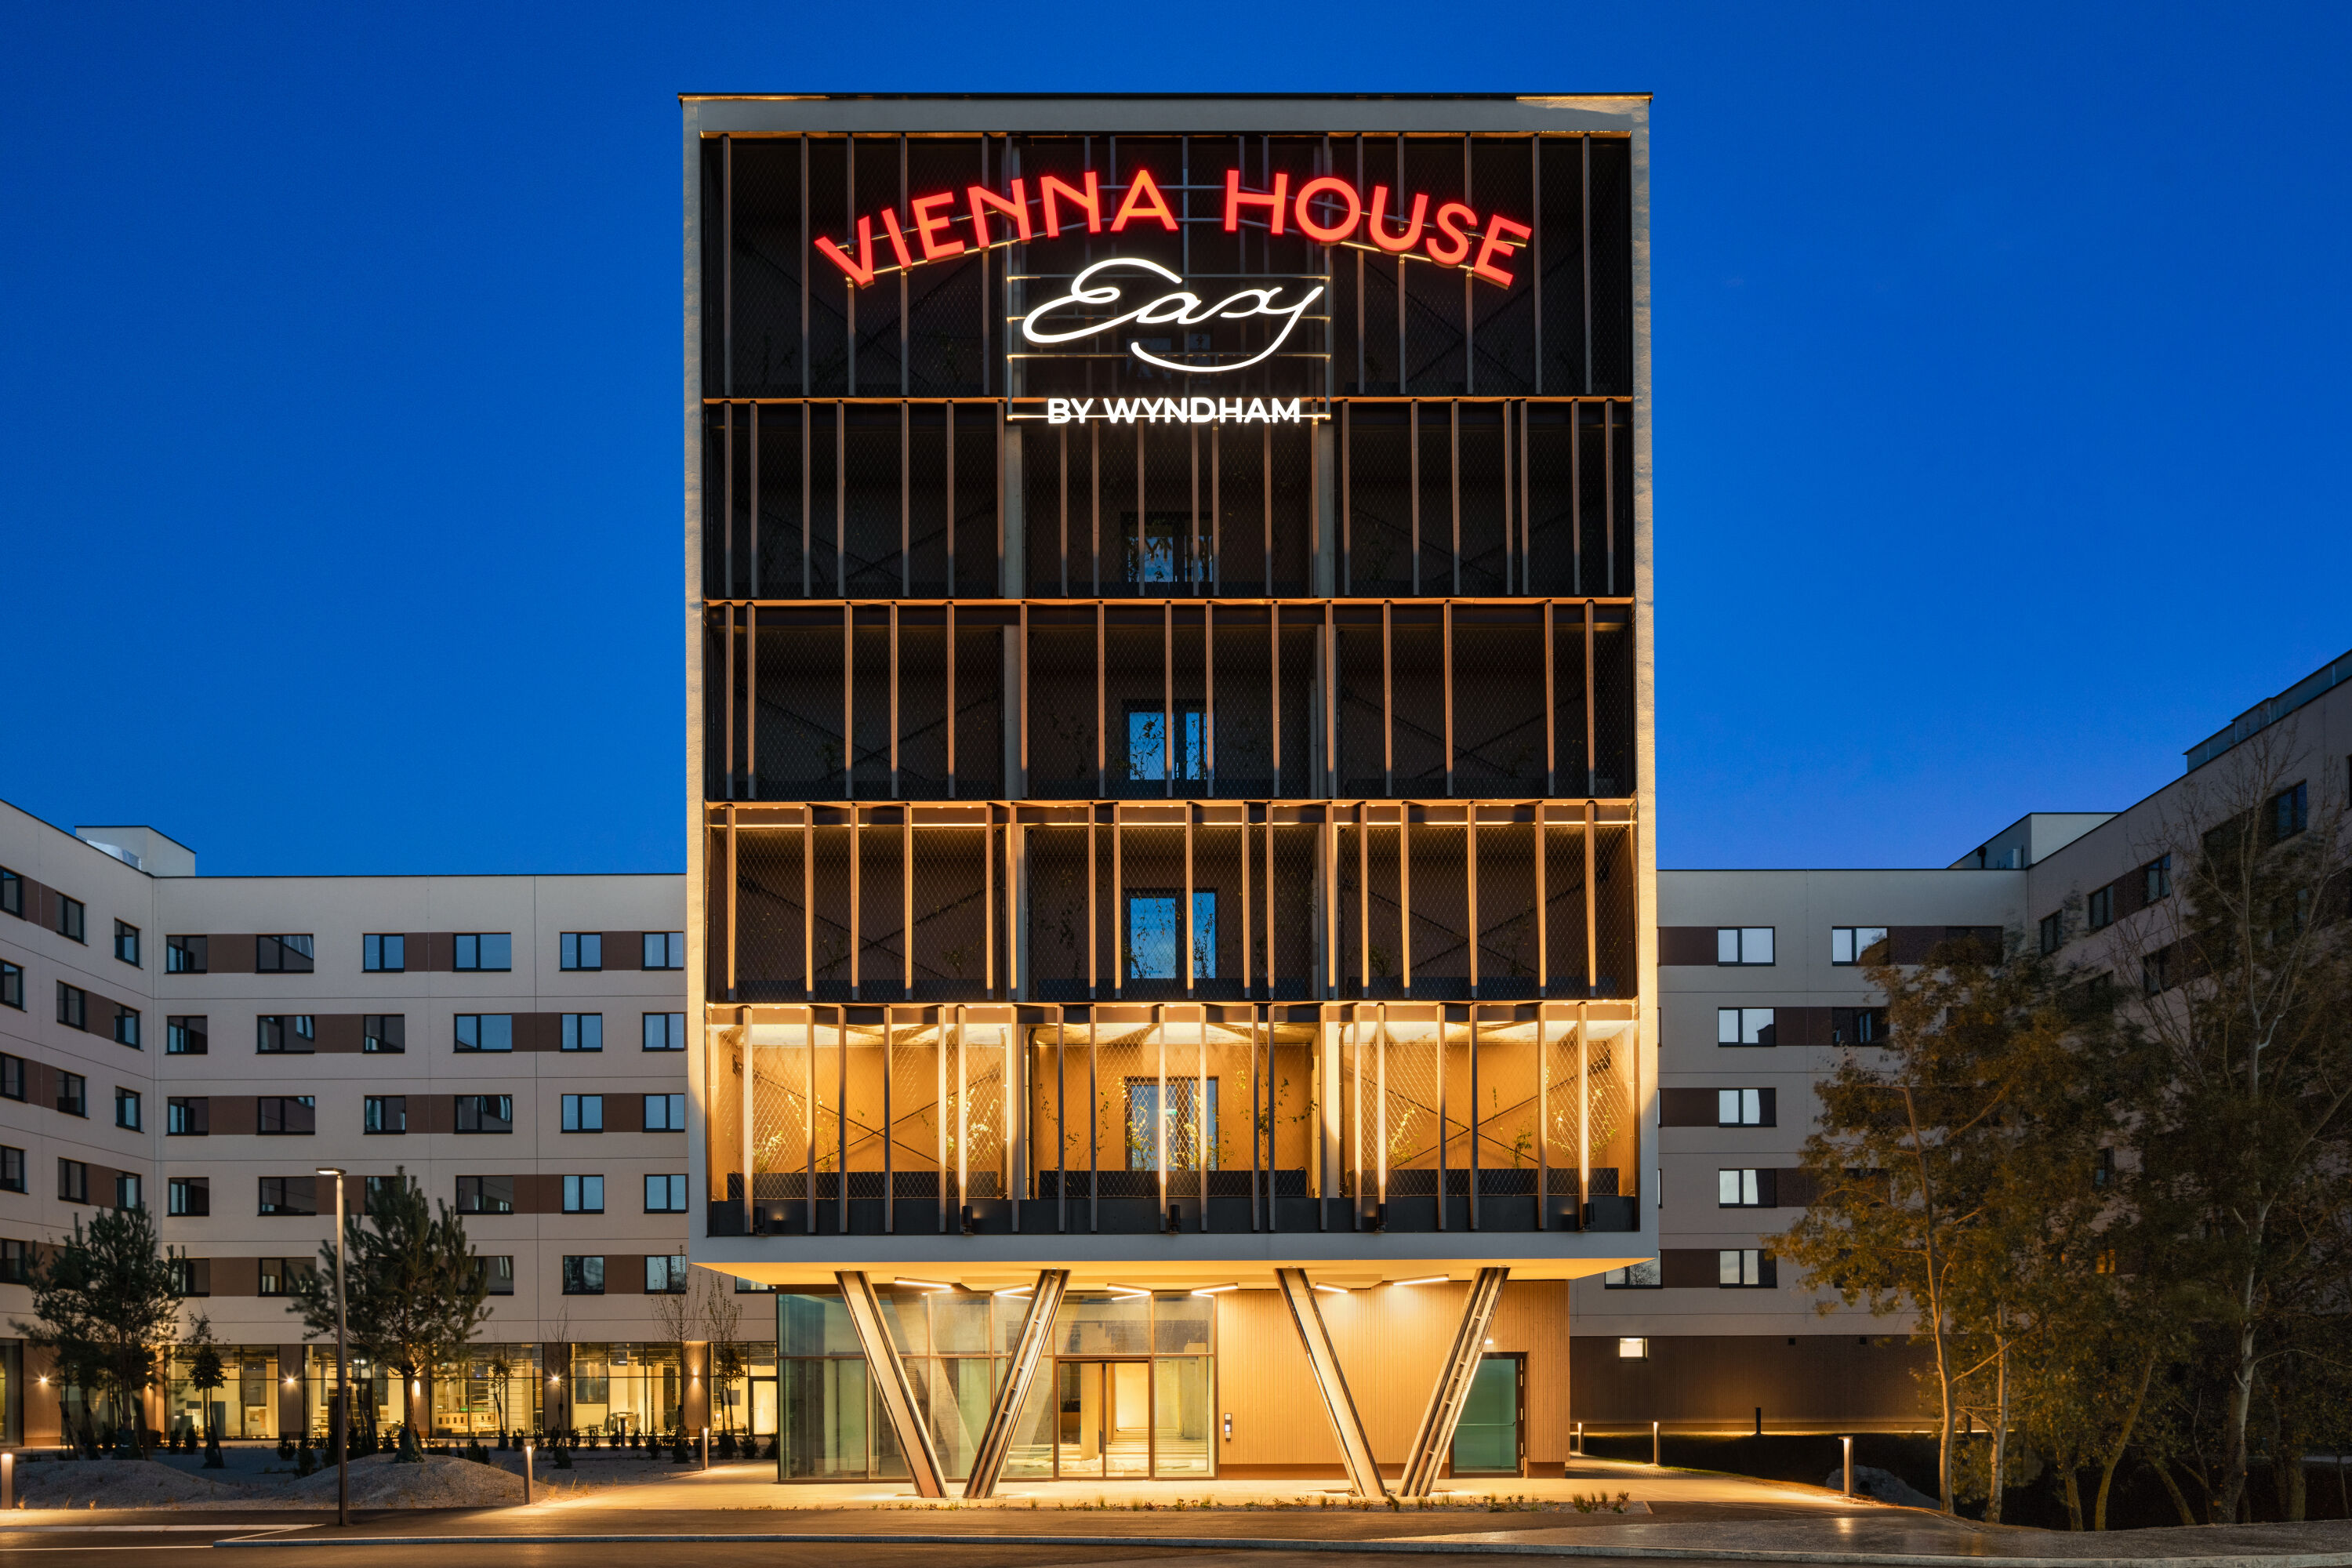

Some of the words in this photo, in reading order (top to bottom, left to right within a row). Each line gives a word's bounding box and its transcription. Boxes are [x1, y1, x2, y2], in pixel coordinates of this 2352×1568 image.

[815, 170, 1179, 286] VIENNA
[1224, 169, 1533, 287] HOUSE
[1022, 257, 1324, 372] Easy
[1047, 397, 1094, 424] BY
[1103, 397, 1301, 424] WYNDHAM
